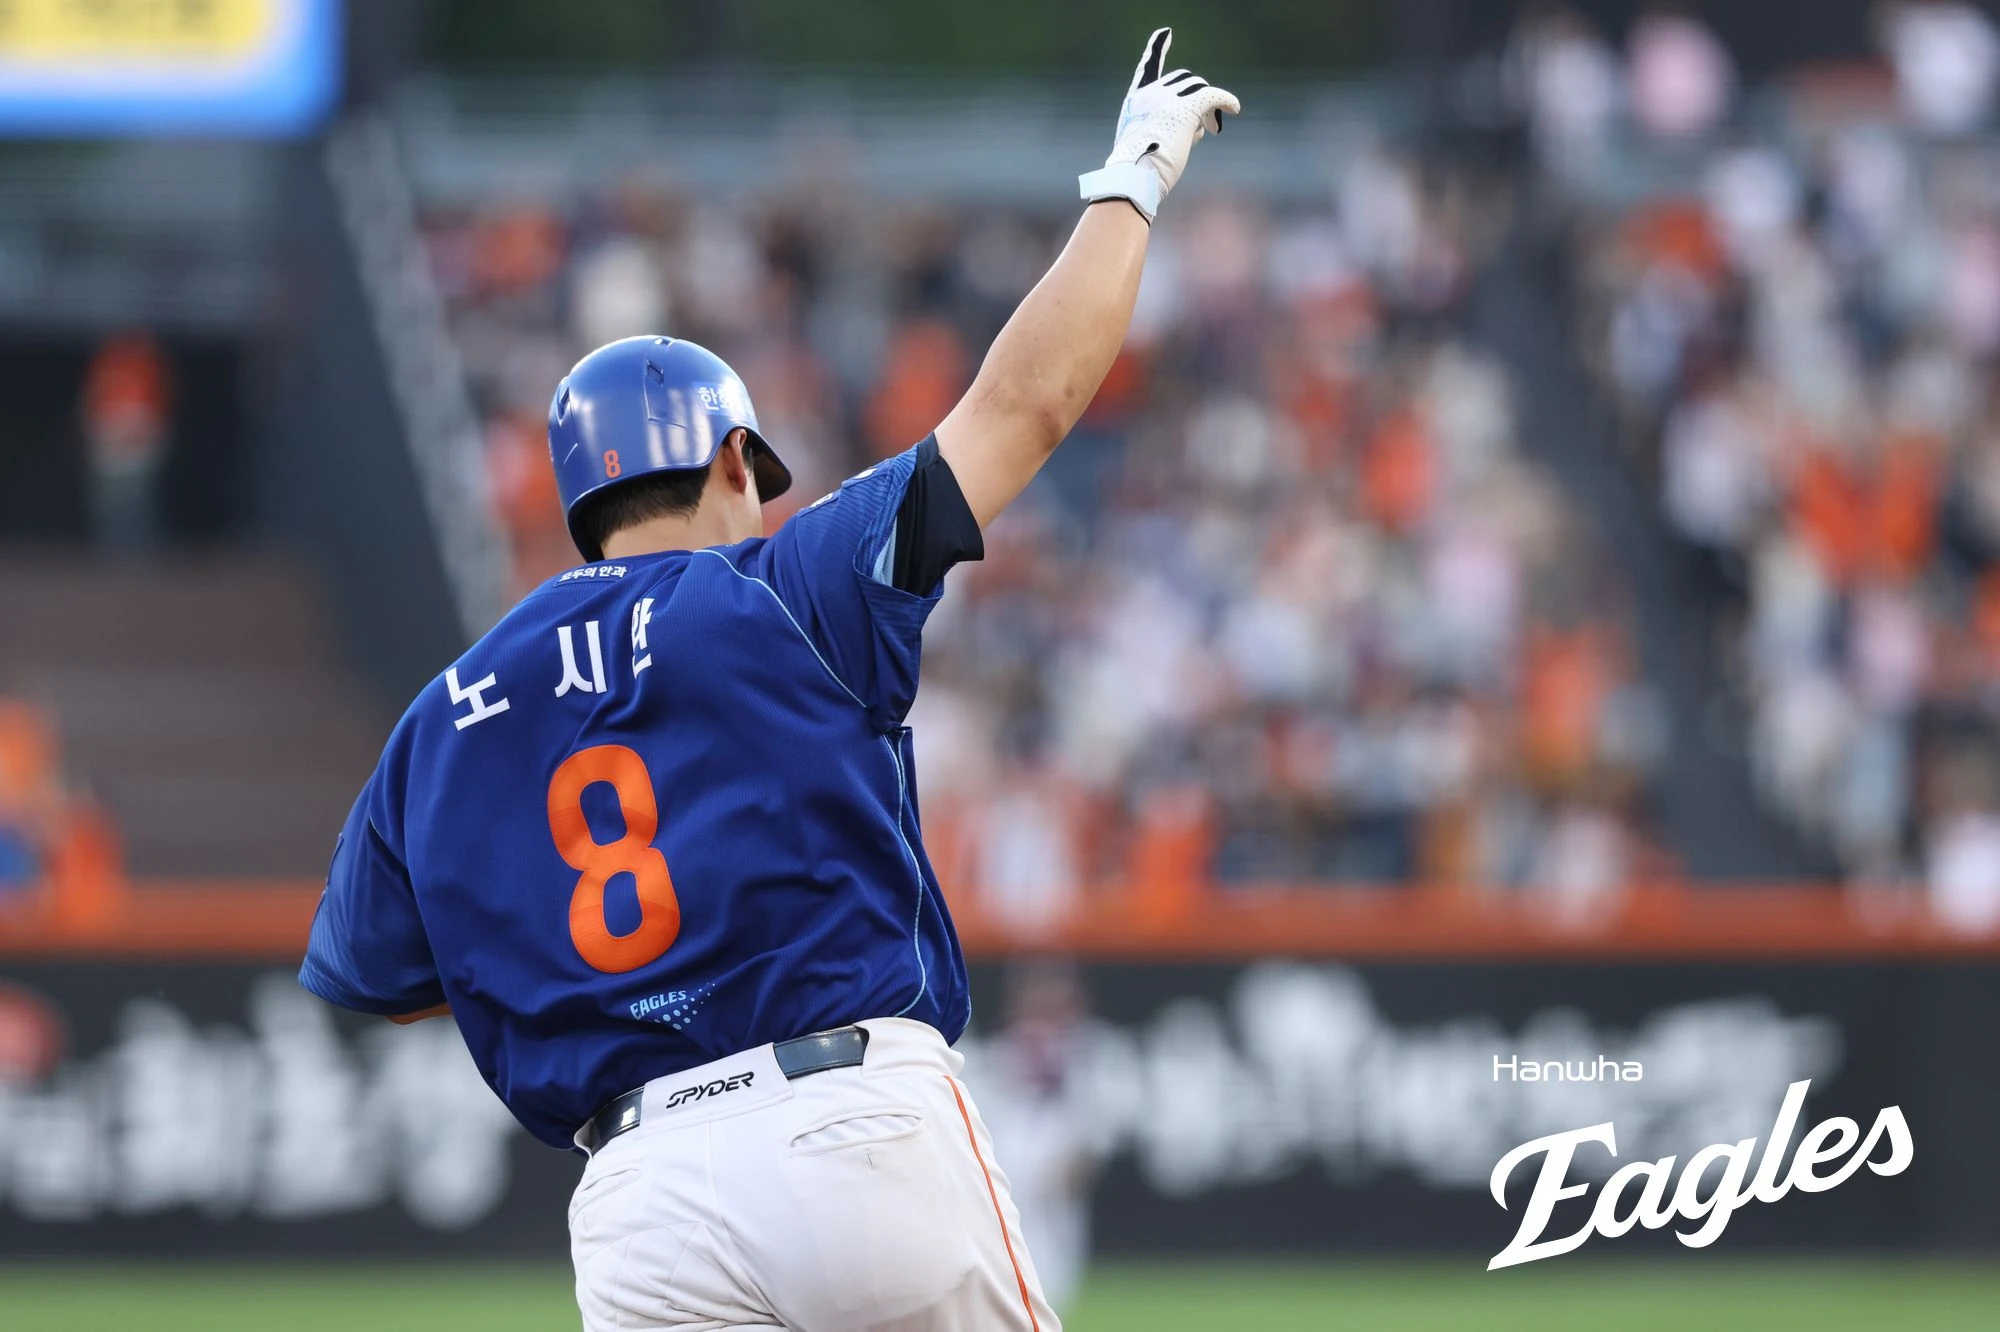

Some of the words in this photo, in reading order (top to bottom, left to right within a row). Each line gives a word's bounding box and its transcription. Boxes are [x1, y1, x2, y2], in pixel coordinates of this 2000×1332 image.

[603, 449, 621, 478] 8
[599, 565, 627, 578] 안과
[547, 744, 680, 973] 8
[629, 990, 687, 1020] EAGLES
[665, 1071, 755, 1110] SPYDER
